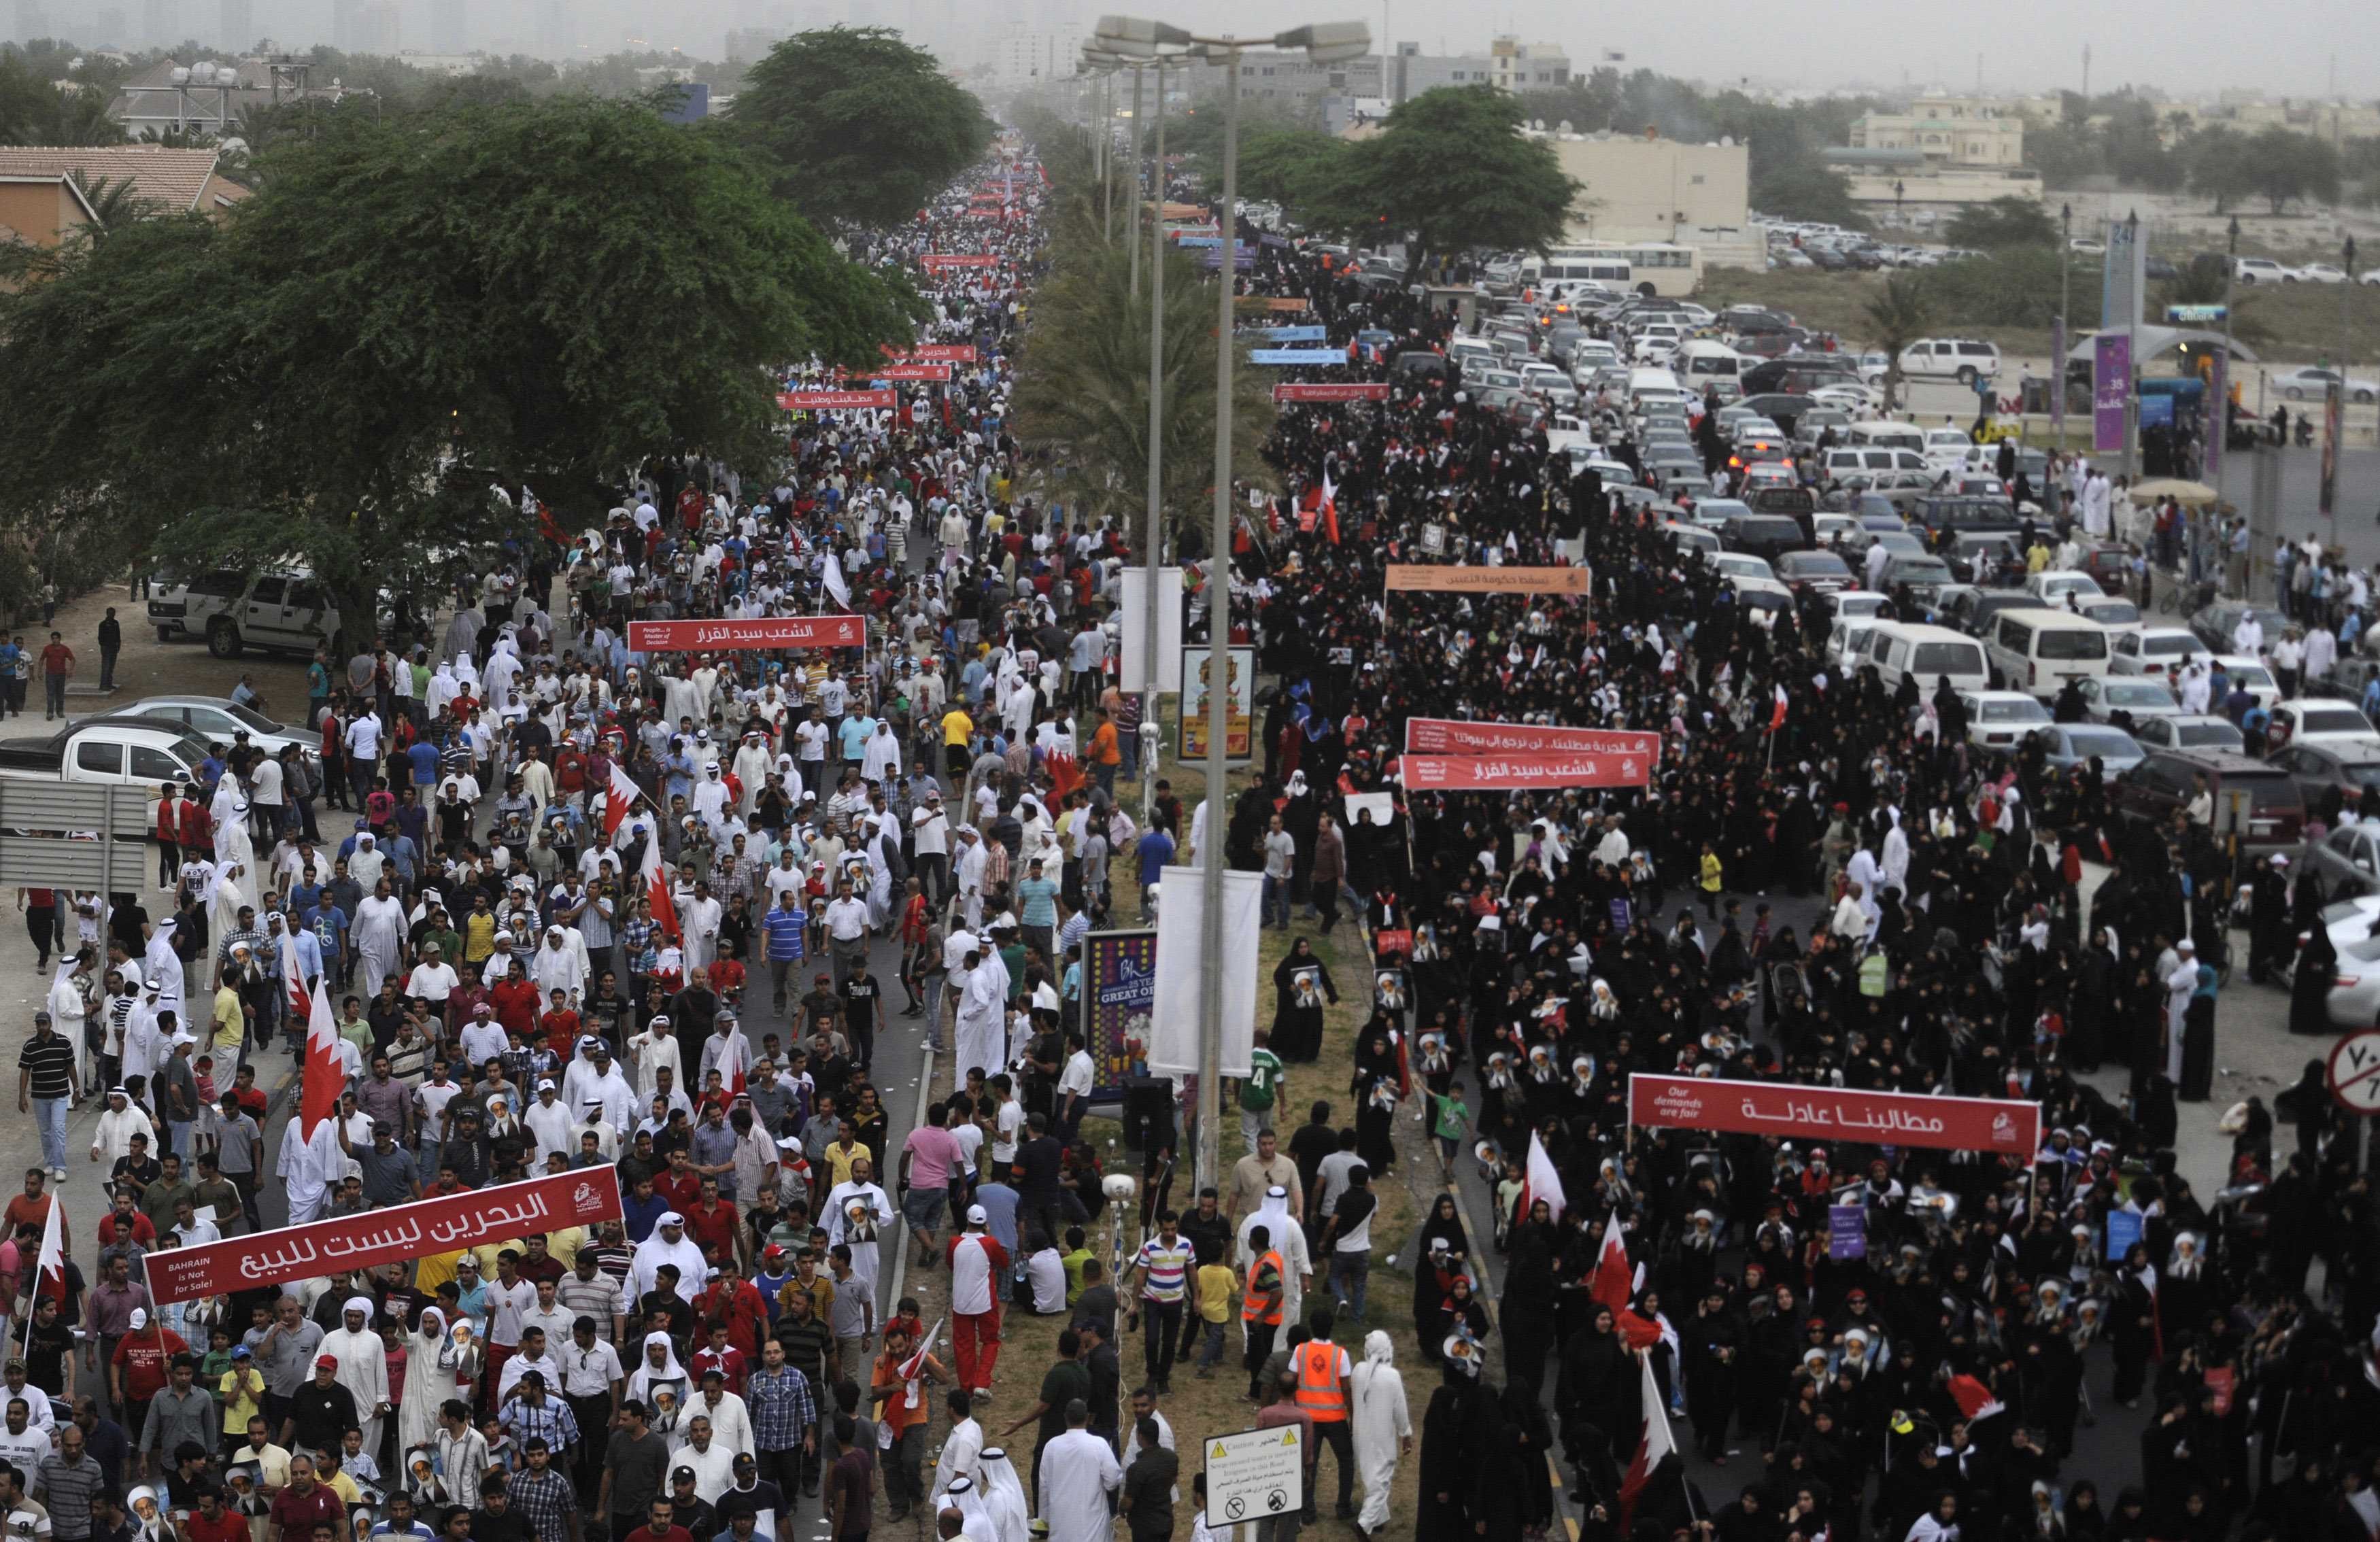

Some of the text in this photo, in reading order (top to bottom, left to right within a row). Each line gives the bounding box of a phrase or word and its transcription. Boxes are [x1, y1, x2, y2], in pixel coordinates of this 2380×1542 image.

[925, 348, 950, 356] البحرين
[830, 396, 872, 405] مطالبنا
[696, 623, 813, 642] الشعب سيد القرار
[1474, 759, 1596, 781] الشعب سيد القرار
[1101, 989, 1138, 1003] GREAT
[1251, 1067, 1265, 1089] 4
[1669, 1086, 1689, 1097] Our
[1654, 1095, 1702, 1108] demands
[1660, 1108, 1699, 1119] are fair
[1741, 1098, 1943, 1133] مطالبنا عادلة
[240, 1193, 549, 1280] البحرين ليست للبيع
[168, 1257, 210, 1272] BAHRAIN
[188, 1270, 205, 1280] Not
[175, 1280, 213, 1295] for Sale!
